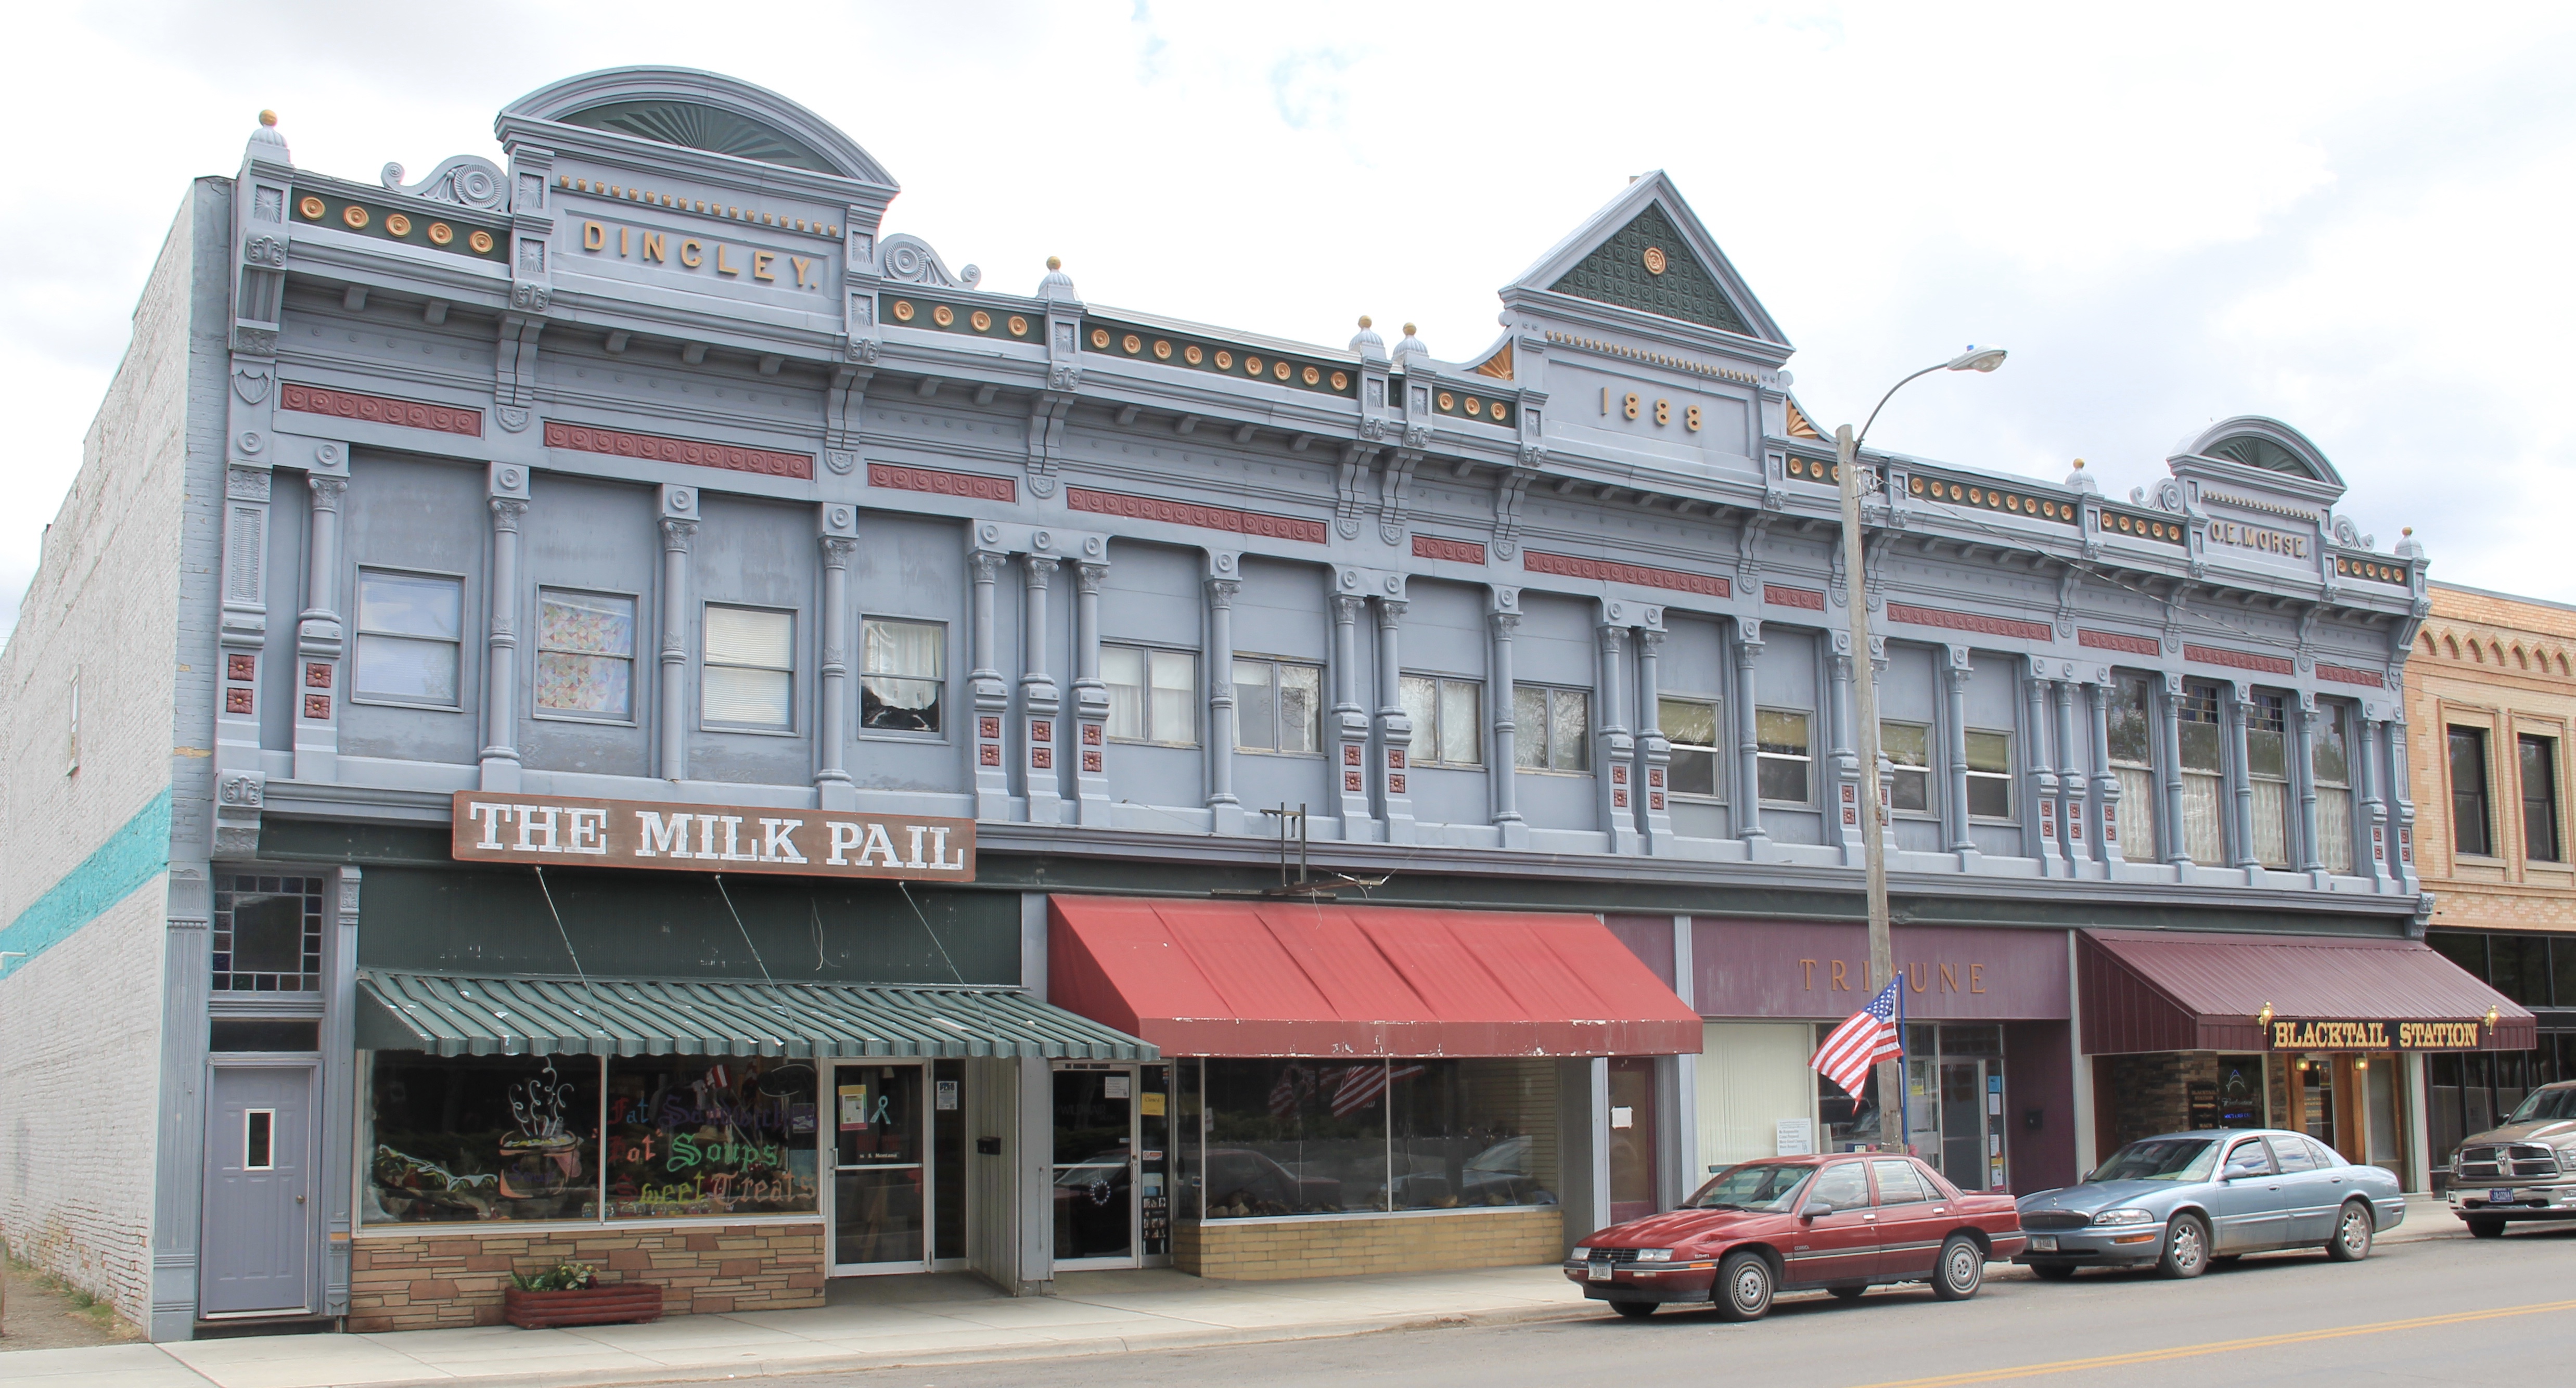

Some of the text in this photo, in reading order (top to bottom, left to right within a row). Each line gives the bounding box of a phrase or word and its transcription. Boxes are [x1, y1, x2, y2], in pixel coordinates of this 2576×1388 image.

[1600, 387, 1701, 432] 1888
[470, 801, 964, 870] THE MILK PAIL
[1798, 959, 1985, 994] TRIUNE
[2274, 1022, 2478, 1048] BLACKTAIL STATION
[667, 1132, 778, 1173] Soups
[616, 1170, 817, 1207] Sweet Treats
